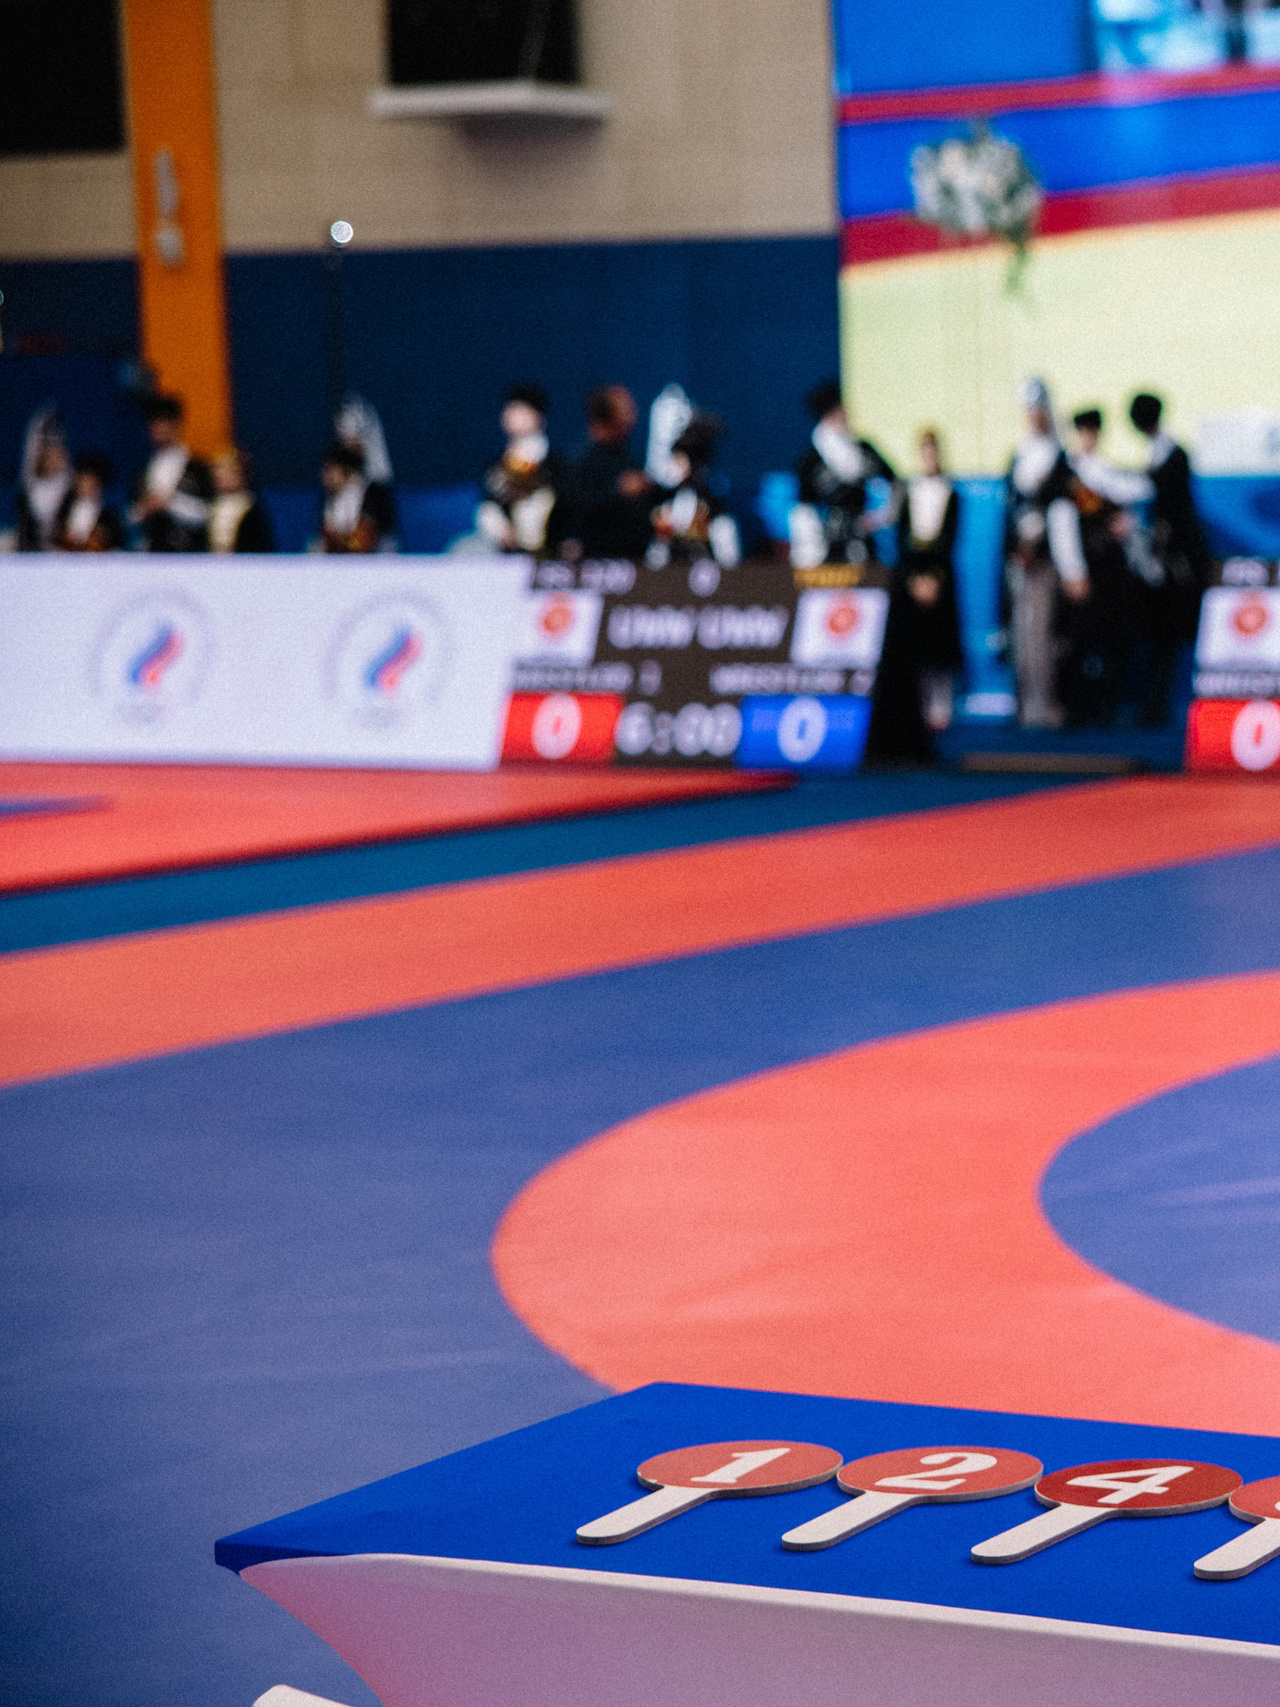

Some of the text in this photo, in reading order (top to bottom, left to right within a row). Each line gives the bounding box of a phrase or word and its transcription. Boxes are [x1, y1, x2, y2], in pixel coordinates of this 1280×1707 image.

[688, 558, 721, 597] 0
[607, 603, 789, 650] UWW UWW
[709, 663, 846, 694] WRESTLER
[531, 692, 582, 760] 0
[615, 701, 743, 757] 6:00
[777, 695, 829, 763] 0
[690, 1447, 791, 1484] 1
[874, 1452, 998, 1490] 2
[1066, 1464, 1195, 1504] 4
